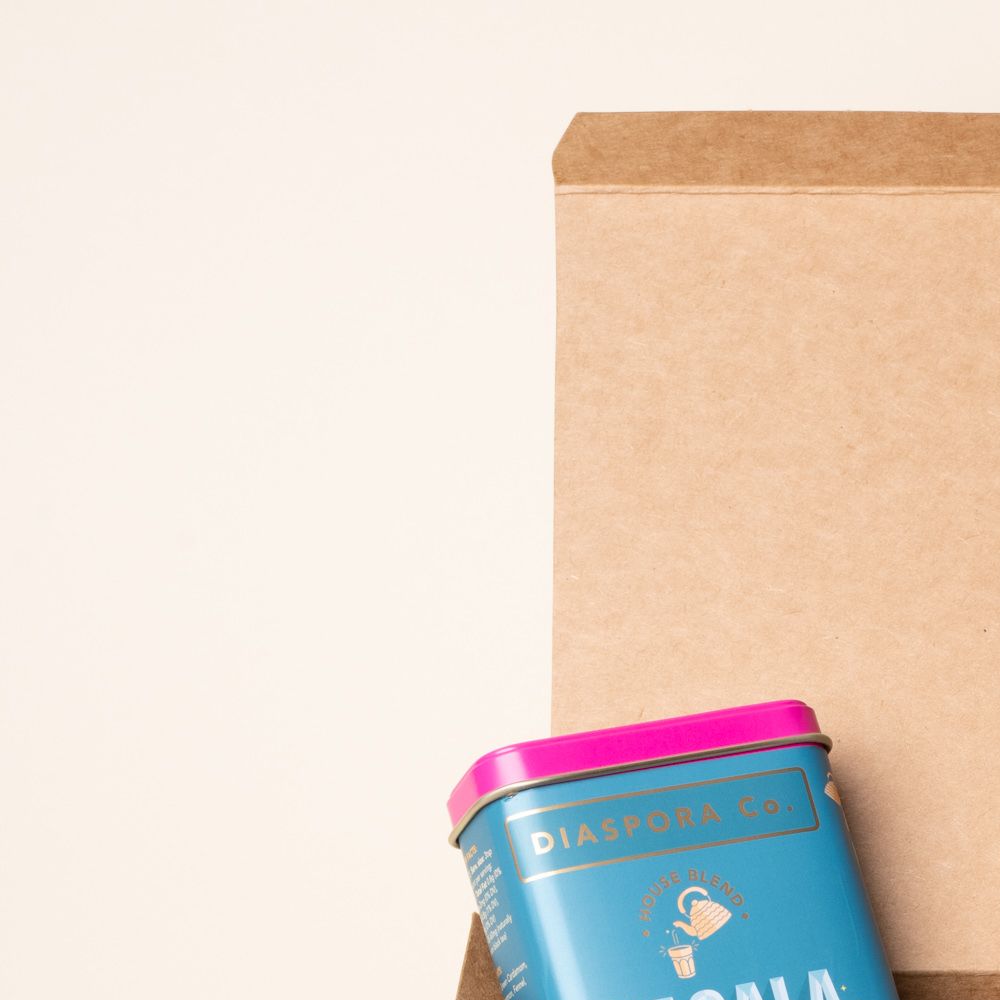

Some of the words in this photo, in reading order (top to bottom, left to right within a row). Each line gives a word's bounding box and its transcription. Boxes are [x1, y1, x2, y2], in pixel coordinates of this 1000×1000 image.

[530, 803, 722, 856] DIASPORA
[738, 796, 793, 817] Co.
[640, 871, 681, 922] HOUSE
[688, 868, 745, 907] BLEND
